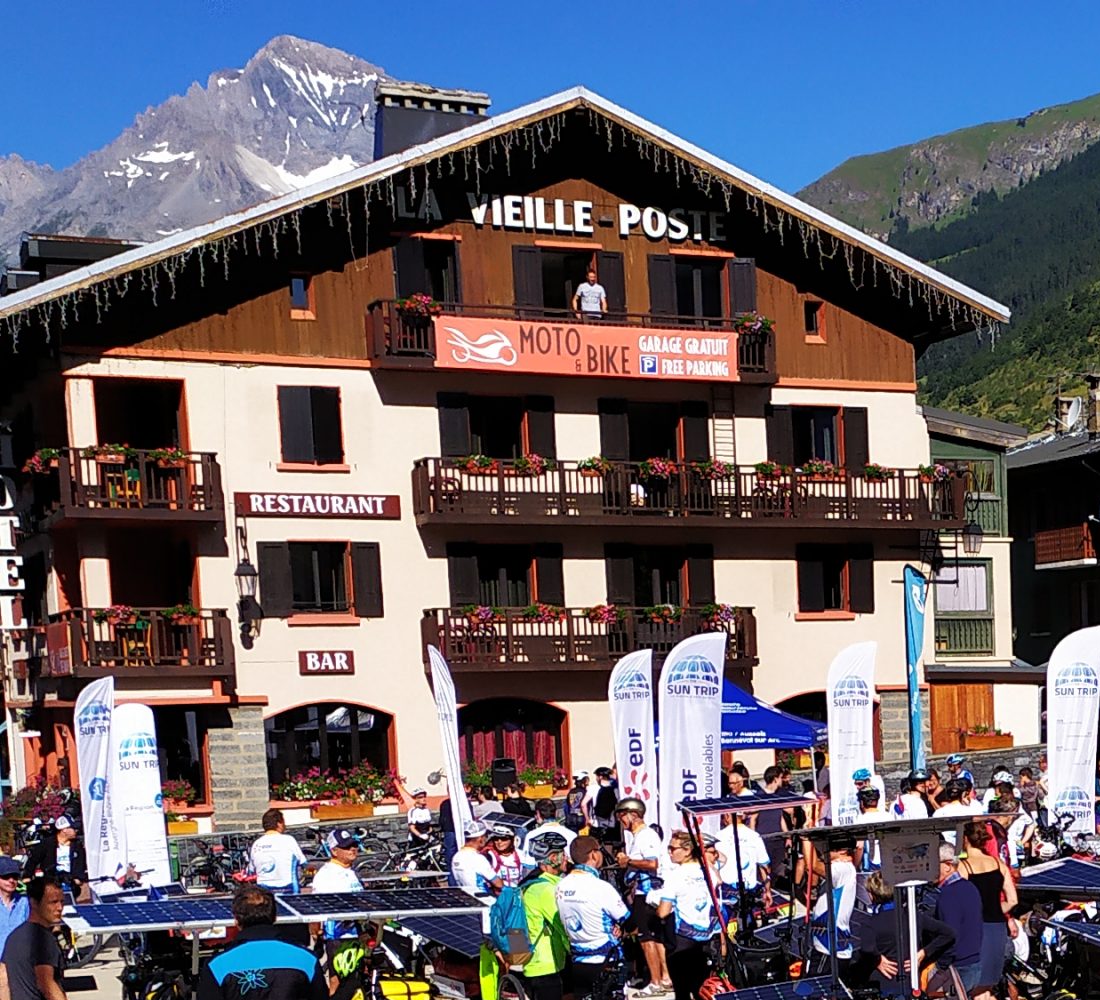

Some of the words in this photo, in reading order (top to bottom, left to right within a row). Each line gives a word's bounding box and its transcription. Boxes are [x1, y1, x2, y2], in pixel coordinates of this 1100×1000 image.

[396, 186, 444, 220] LA
[466, 193, 594, 232] VIEILLE
[618, 203, 727, 241] POSTE
[519, 324, 581, 356] MOTO
[638, 335, 682, 354] GARAGE
[685, 337, 729, 356] GRATUIT
[587, 344, 631, 374] BIKE
[661, 359, 684, 375] FREE
[686, 359, 729, 376] PARKING
[249, 494, 387, 514] RESTAURANT
[306, 652, 349, 670] BAR
[614, 691, 631, 701] SUN
[632, 691, 650, 699] TRIP
[667, 685, 691, 695] SUN
[694, 685, 719, 696] TRIP
[1055, 687, 1075, 696] SUN
[1076, 687, 1098, 696] TRIP
[833, 699, 850, 707] SUN
[852, 699, 869, 707] TRIP
[119, 761, 140, 771] SUN
